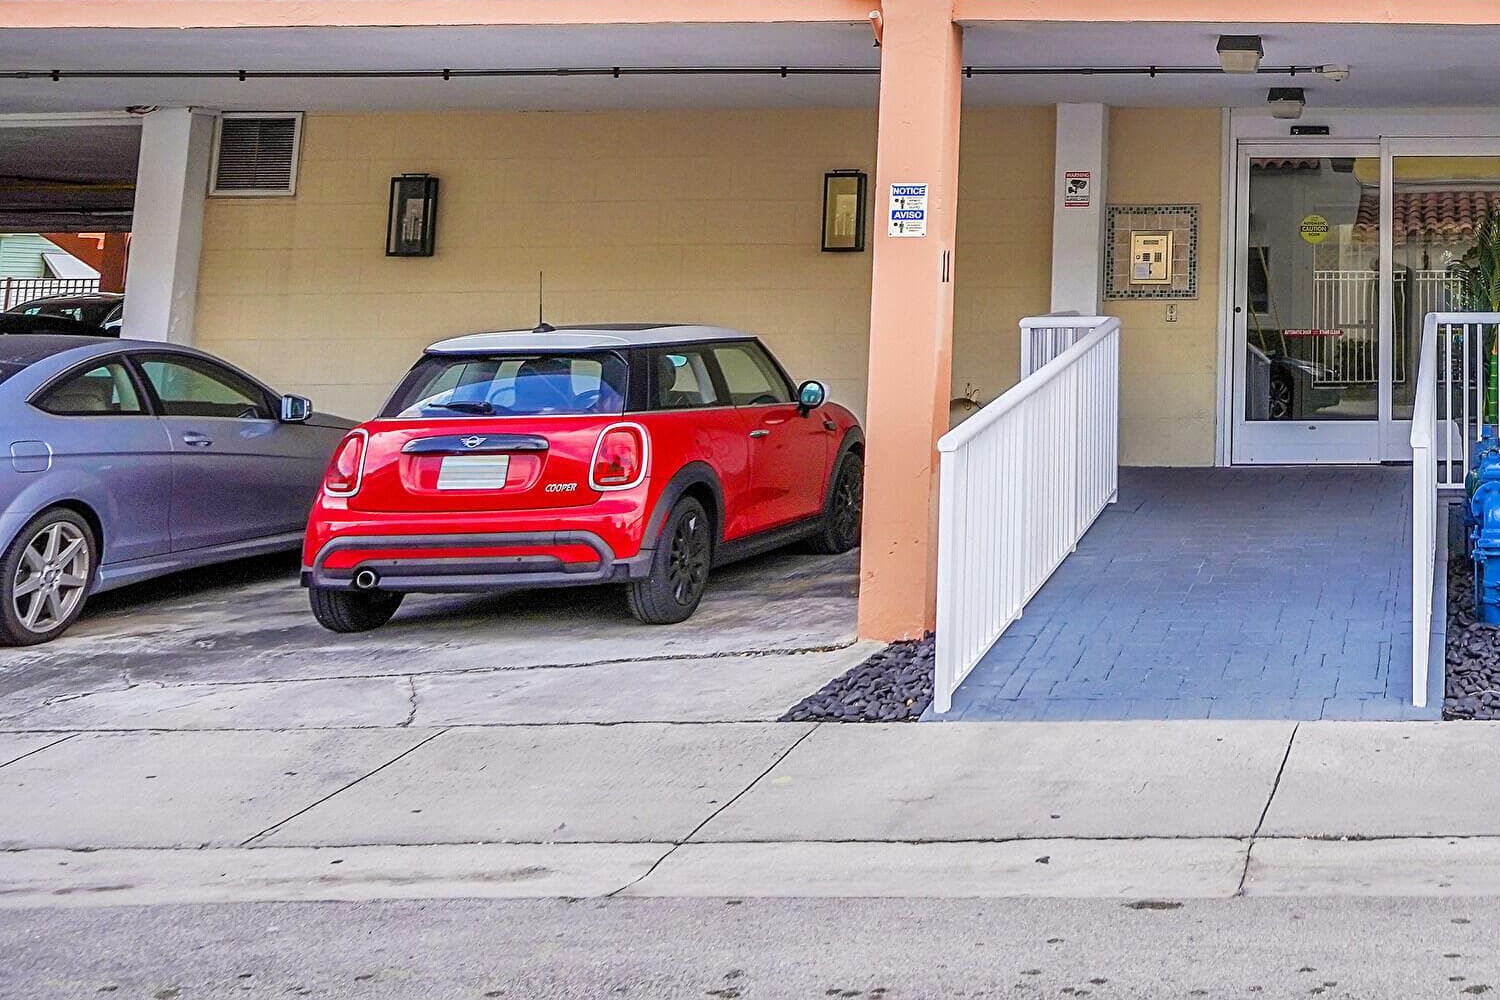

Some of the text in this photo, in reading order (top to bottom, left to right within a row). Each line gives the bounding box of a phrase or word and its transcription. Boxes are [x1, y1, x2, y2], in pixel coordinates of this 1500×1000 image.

[893, 187, 926, 195] NOTICE
[894, 211, 922, 219] AVISO
[545, 483, 577, 492] COOPER
